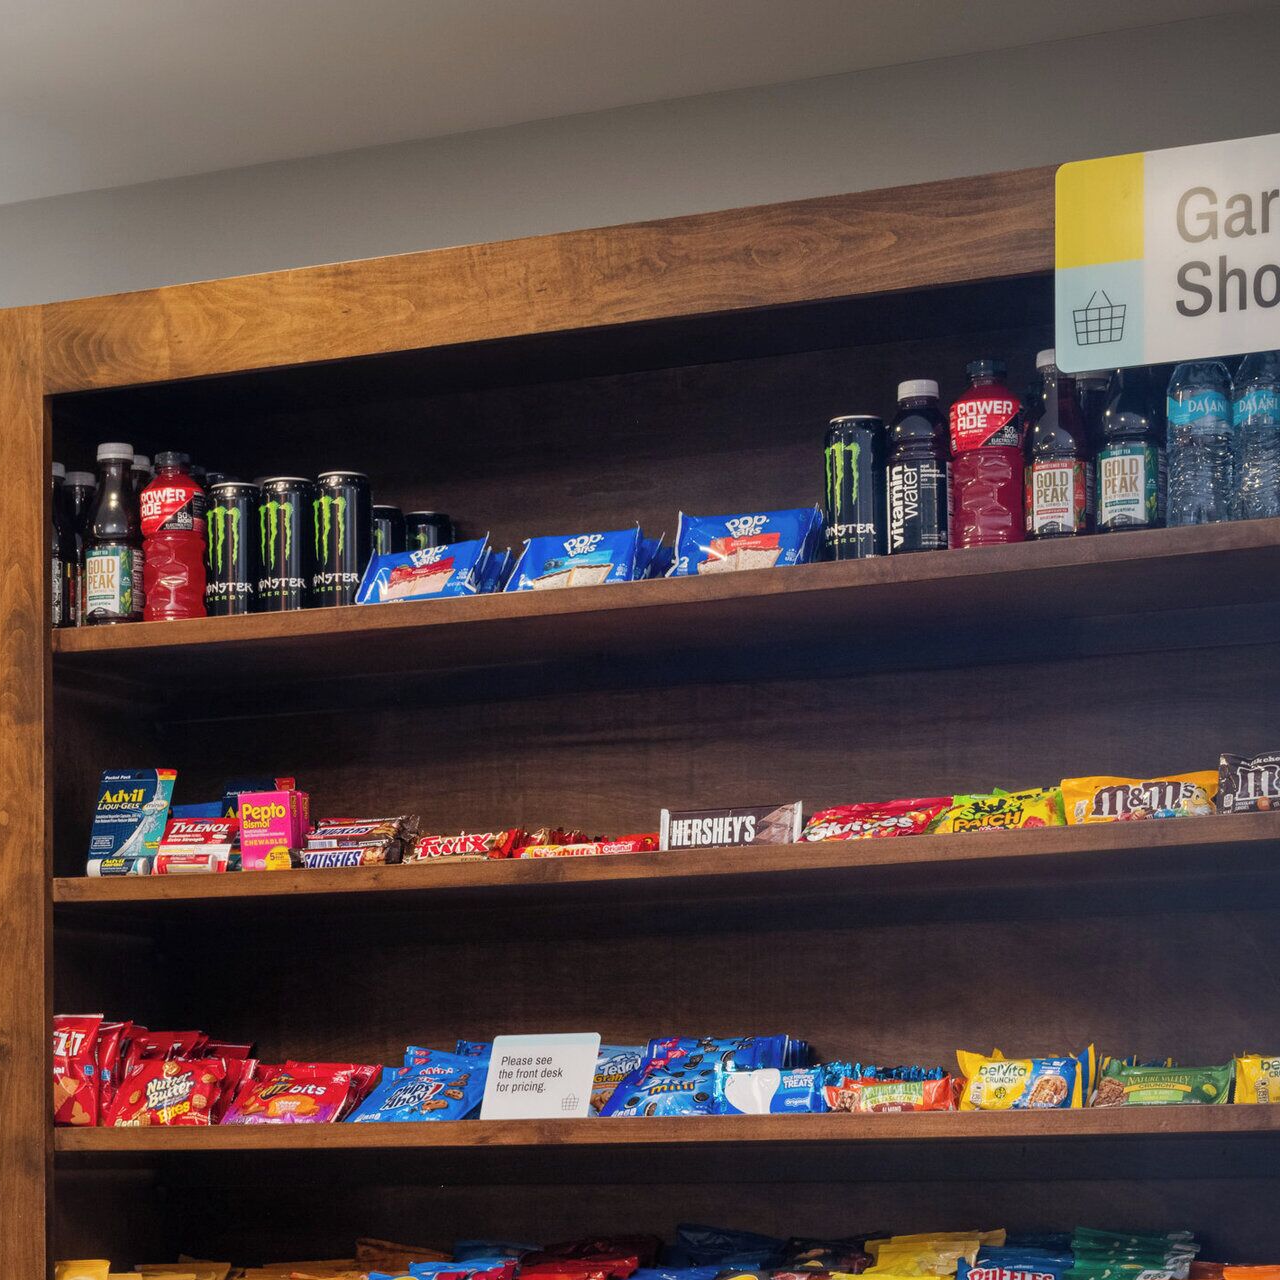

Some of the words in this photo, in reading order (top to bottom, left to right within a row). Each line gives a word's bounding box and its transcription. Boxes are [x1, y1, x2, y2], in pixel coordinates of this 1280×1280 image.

[957, 400, 1013, 416] POWER
[957, 415, 988, 432] ADE
[1104, 457, 1139, 478] GOLD
[1036, 471, 1069, 488] GOLD
[1104, 476, 1140, 495] PEAK
[141, 488, 186, 504] POWER
[1036, 487, 1069, 503] PEAK
[142, 502, 161, 517] ADE
[891, 465, 904, 549] vitamin
[904, 464, 918, 520] water
[825, 523, 876, 537] ONSTER
[88, 559, 115, 574] GOLD
[89, 575, 114, 589] PEAK
[258, 577, 307, 590] ONSTER
[313, 572, 360, 584] ONSTER
[207, 582, 253, 596] ONSTER
[98, 788, 146, 803] Advil
[242, 802, 286, 820] Pepto
[170, 822, 231, 834] TYLENOL
[243, 818, 270, 829] Bismol
[953, 810, 1024, 833] PATCH
[671, 815, 756, 847] HERSHEY'S
[807, 816, 914, 843] Skites
[244, 838, 288, 847] CHEWABLES
[602, 843, 632, 854] Original
[270, 852, 275, 860] 5
[304, 851, 362, 868] SATISFIES
[501, 1055, 533, 1066] Please
[535, 1056, 553, 1066] see
[498, 1068, 513, 1079] the
[516, 1068, 538, 1079] front
[540, 1067, 564, 1078] desk
[979, 1064, 1027, 1077] belVita
[147, 1071, 193, 1097] Nutter
[496, 1082, 509, 1092] for
[511, 1081, 546, 1093] pricing.
[783, 1080, 814, 1088] TREATS
[985, 1076, 1018, 1084] CRUNCHY
[1128, 1075, 1161, 1086] NATURE
[1162, 1075, 1191, 1084] VALLEY
[148, 1080, 195, 1108] Butter
[289, 1084, 327, 1096] bits
[157, 1101, 191, 1124] Bites
